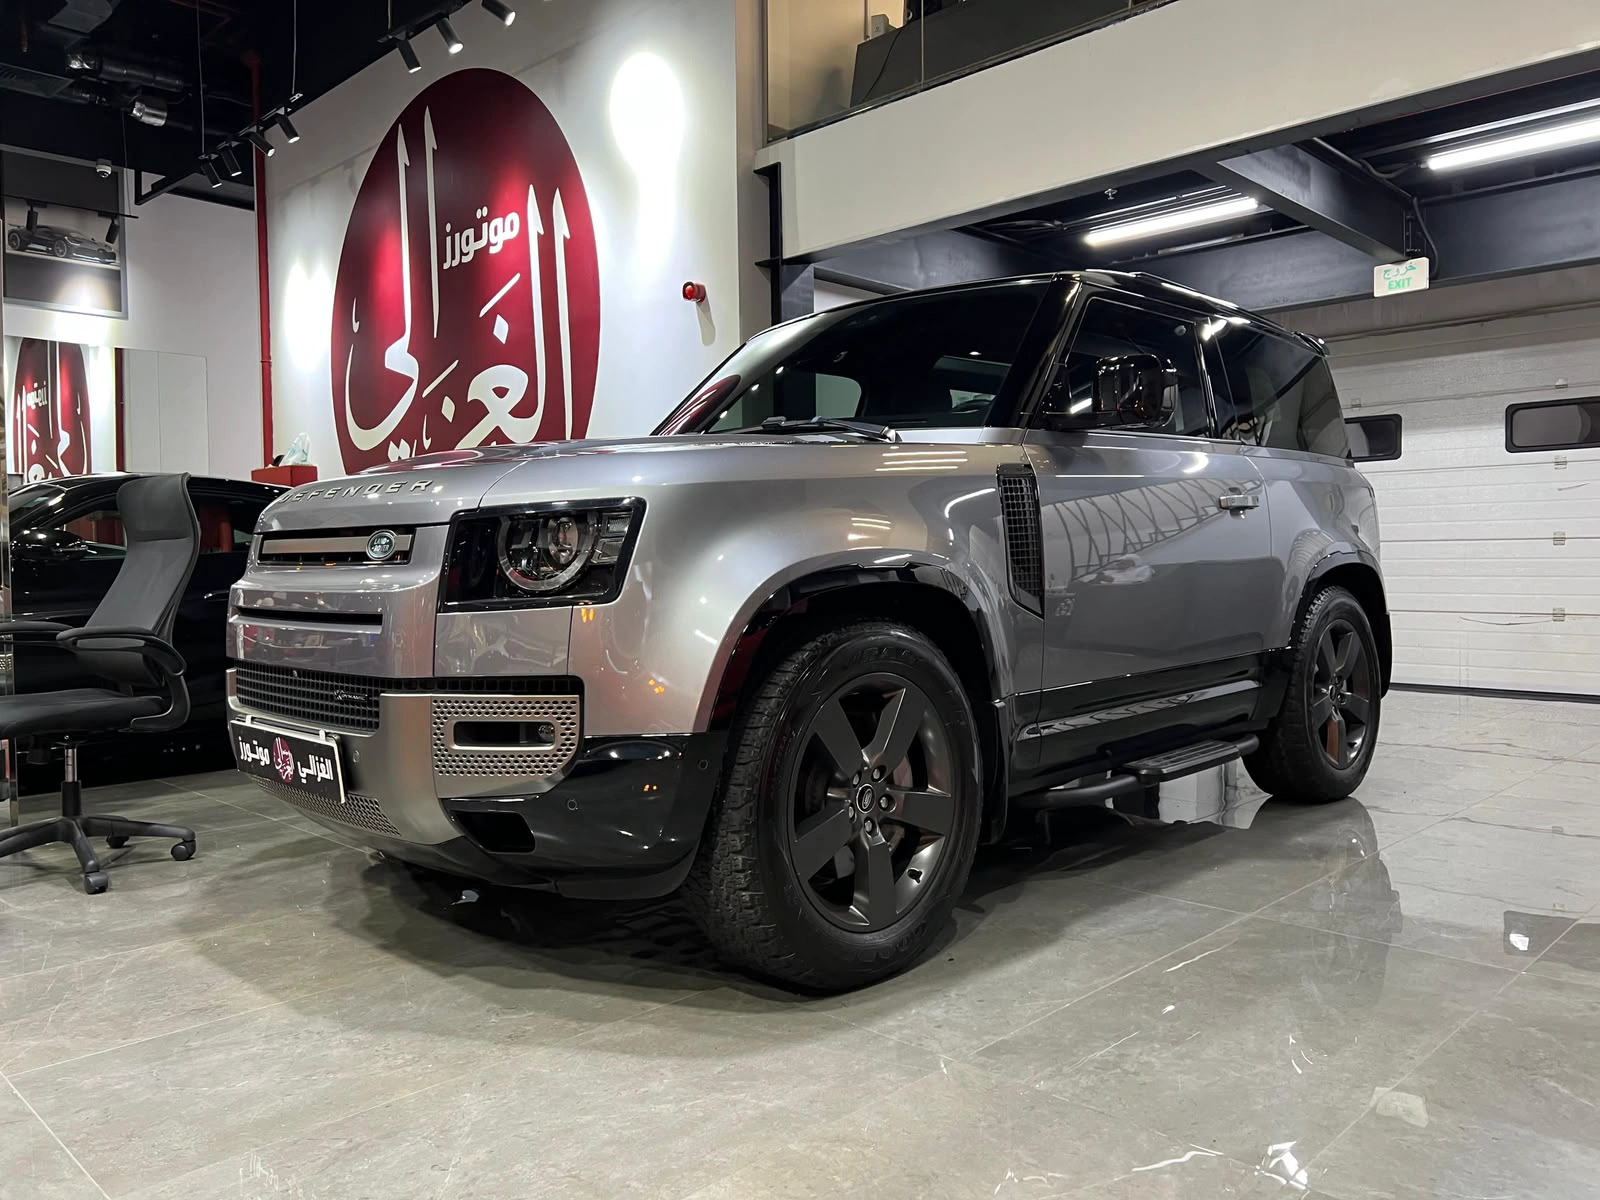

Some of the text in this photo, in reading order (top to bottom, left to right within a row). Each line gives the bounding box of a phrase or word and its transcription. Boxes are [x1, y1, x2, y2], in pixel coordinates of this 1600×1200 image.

[443, 206, 520, 270] موتورز
[1383, 261, 1417, 281] خروج
[1388, 277, 1412, 290] EXIT
[278, 479, 433, 504] DEFENDER
[238, 736, 334, 784] الغزالي موتورز
